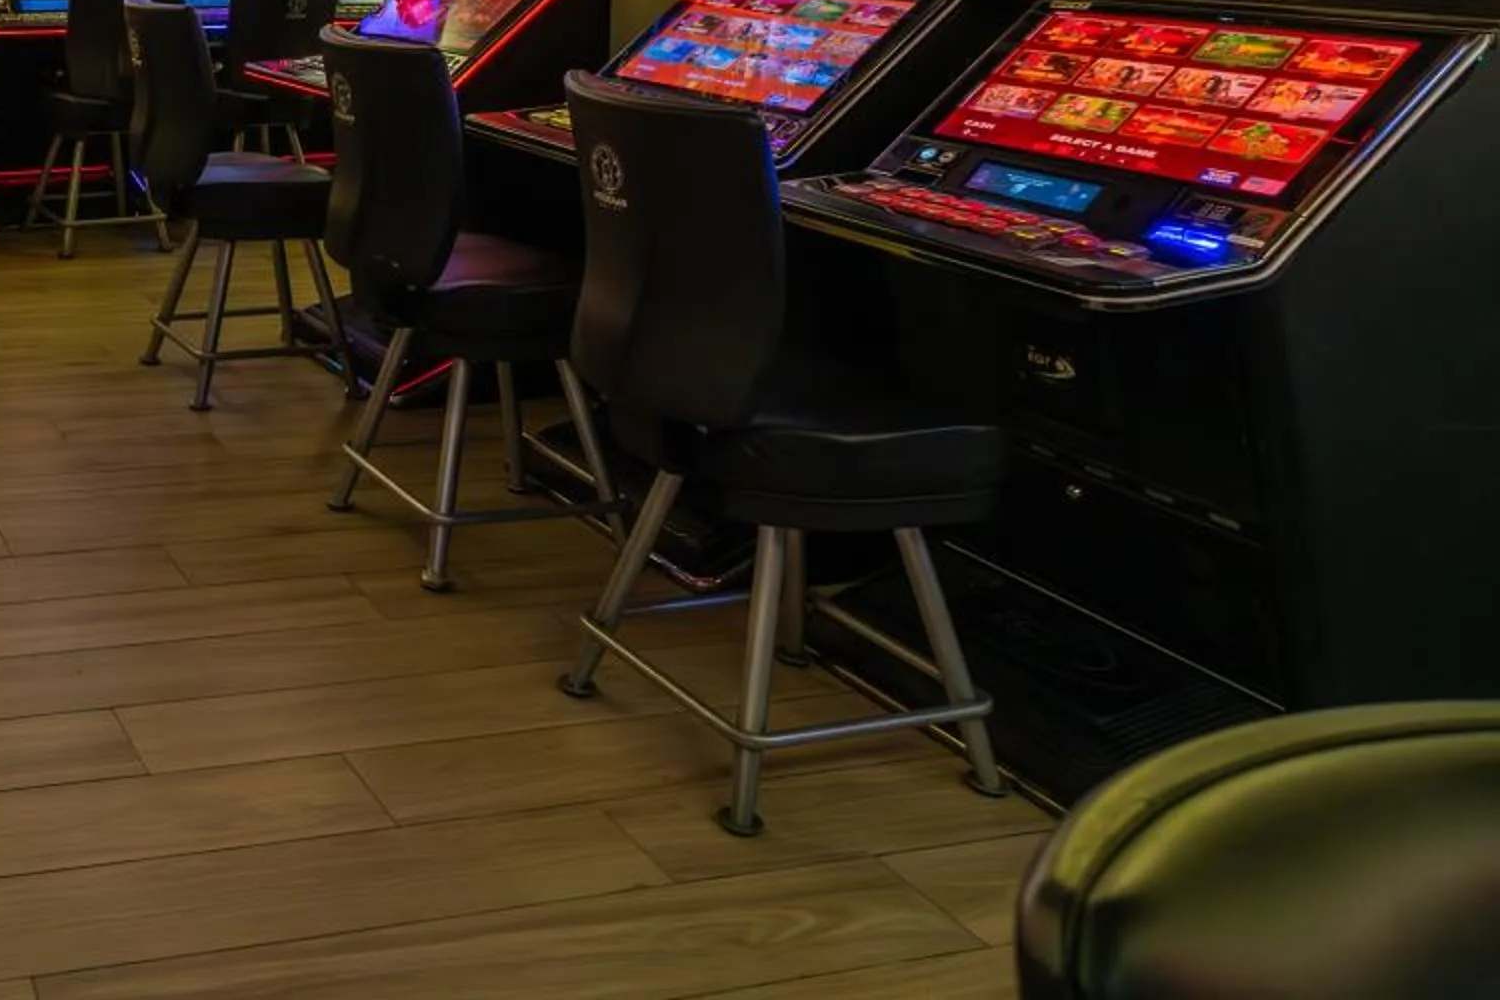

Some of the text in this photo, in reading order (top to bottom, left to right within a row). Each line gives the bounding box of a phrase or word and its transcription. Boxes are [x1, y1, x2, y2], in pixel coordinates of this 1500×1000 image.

[963, 118, 997, 131] CASH
[1049, 133, 1159, 159] SELECT A GAME
